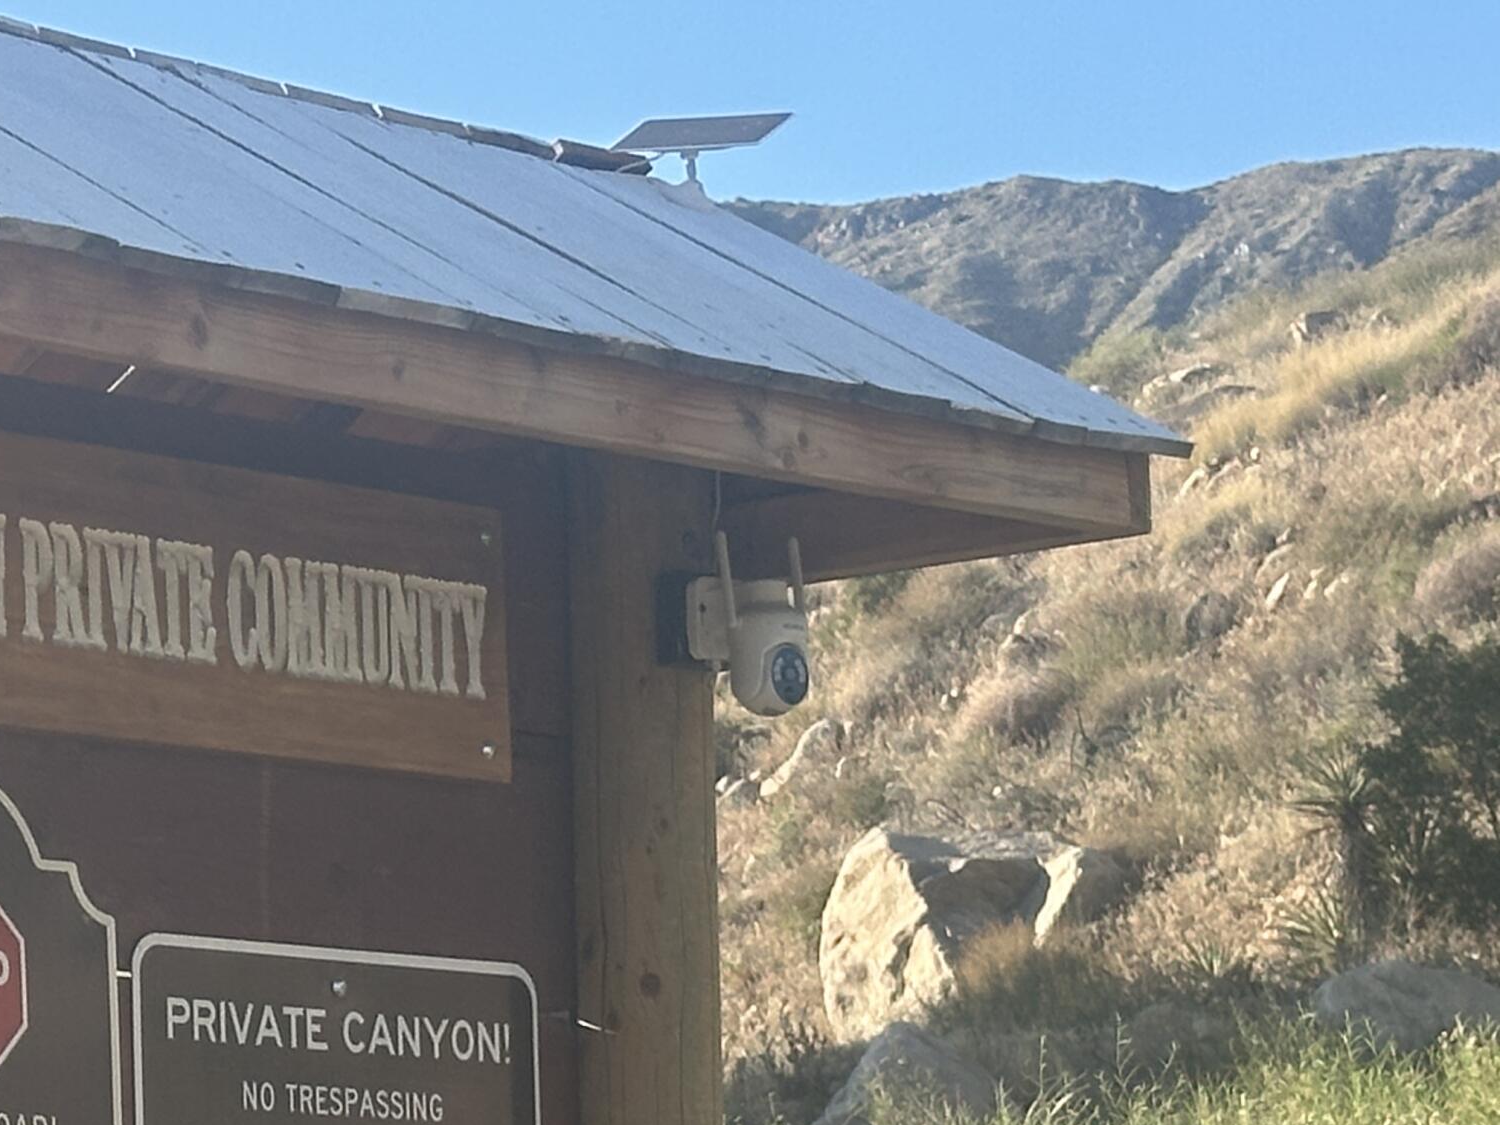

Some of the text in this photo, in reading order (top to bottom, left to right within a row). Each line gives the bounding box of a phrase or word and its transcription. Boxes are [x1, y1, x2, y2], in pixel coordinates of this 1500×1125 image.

[19, 517, 218, 666] PRIVATE
[227, 548, 488, 701] COMMUNITY
[166, 996, 512, 1064] PRIVATE CANYON!
[242, 1080, 444, 1122] NO TRESPASSING
